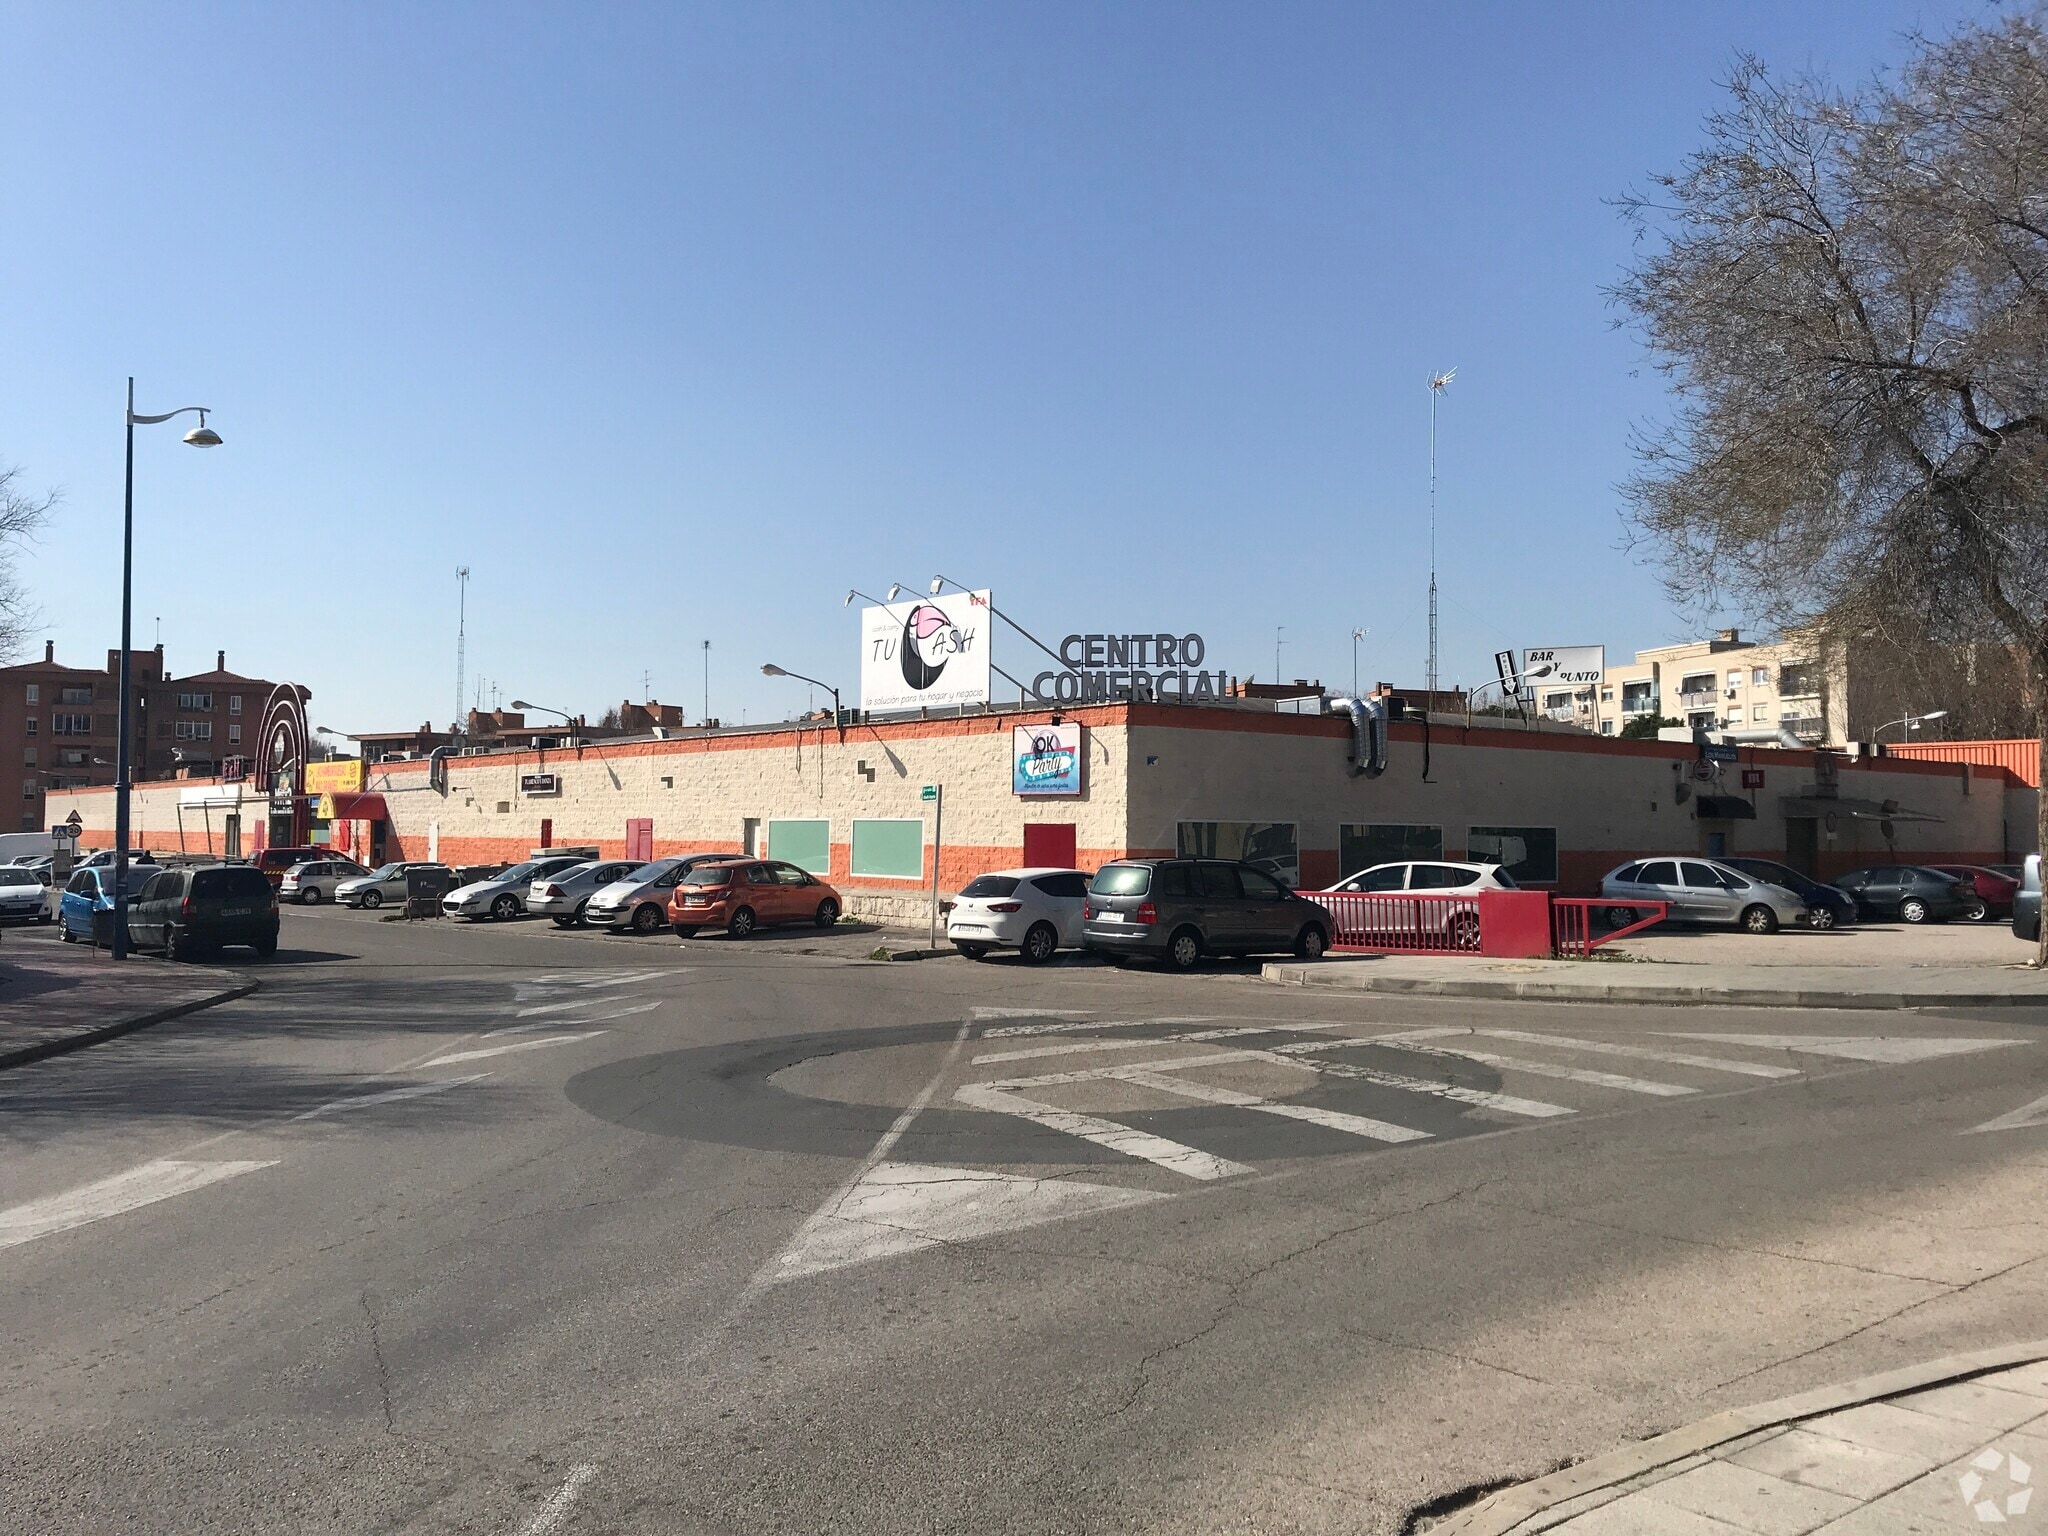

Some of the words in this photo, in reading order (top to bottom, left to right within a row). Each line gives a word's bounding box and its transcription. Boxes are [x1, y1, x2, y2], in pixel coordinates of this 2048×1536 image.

[873, 638, 897, 662] TU
[1060, 633, 1205, 668] CENTRO
[1530, 651, 1554, 662] BAR
[1553, 662, 1561, 671] Y
[865, 697, 873, 705] la
[873, 695, 900, 706] solución
[900, 695, 917, 706] para
[928, 692, 948, 704] hogar
[955, 689, 984, 700] negocio
[1033, 670, 1237, 706] COMERCIAL
[1036, 735, 1054, 752] OK
[1032, 754, 1062, 779] Party
